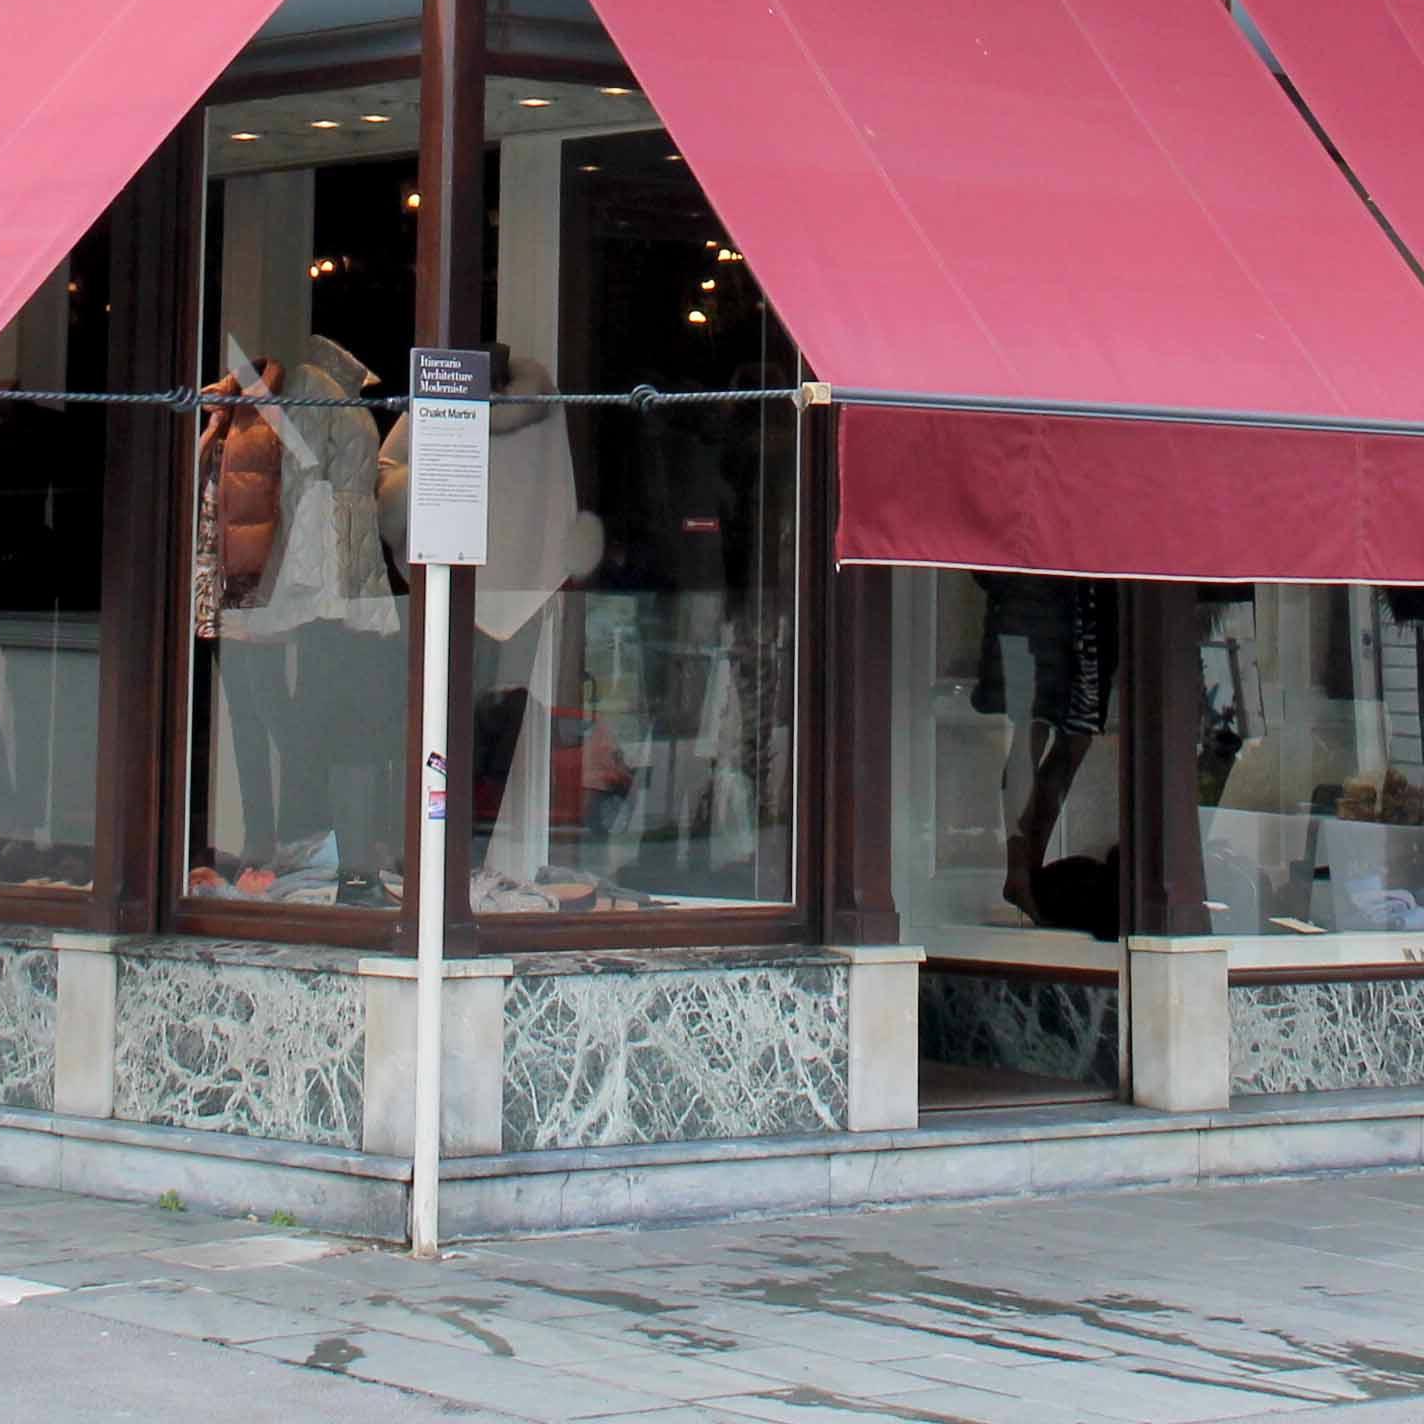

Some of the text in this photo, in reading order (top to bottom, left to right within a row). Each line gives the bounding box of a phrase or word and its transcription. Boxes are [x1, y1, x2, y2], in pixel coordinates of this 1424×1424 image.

[420, 355, 462, 368] Itinerario
[419, 368, 473, 381] Architetture
[419, 407, 476, 419] Chalet Martini
